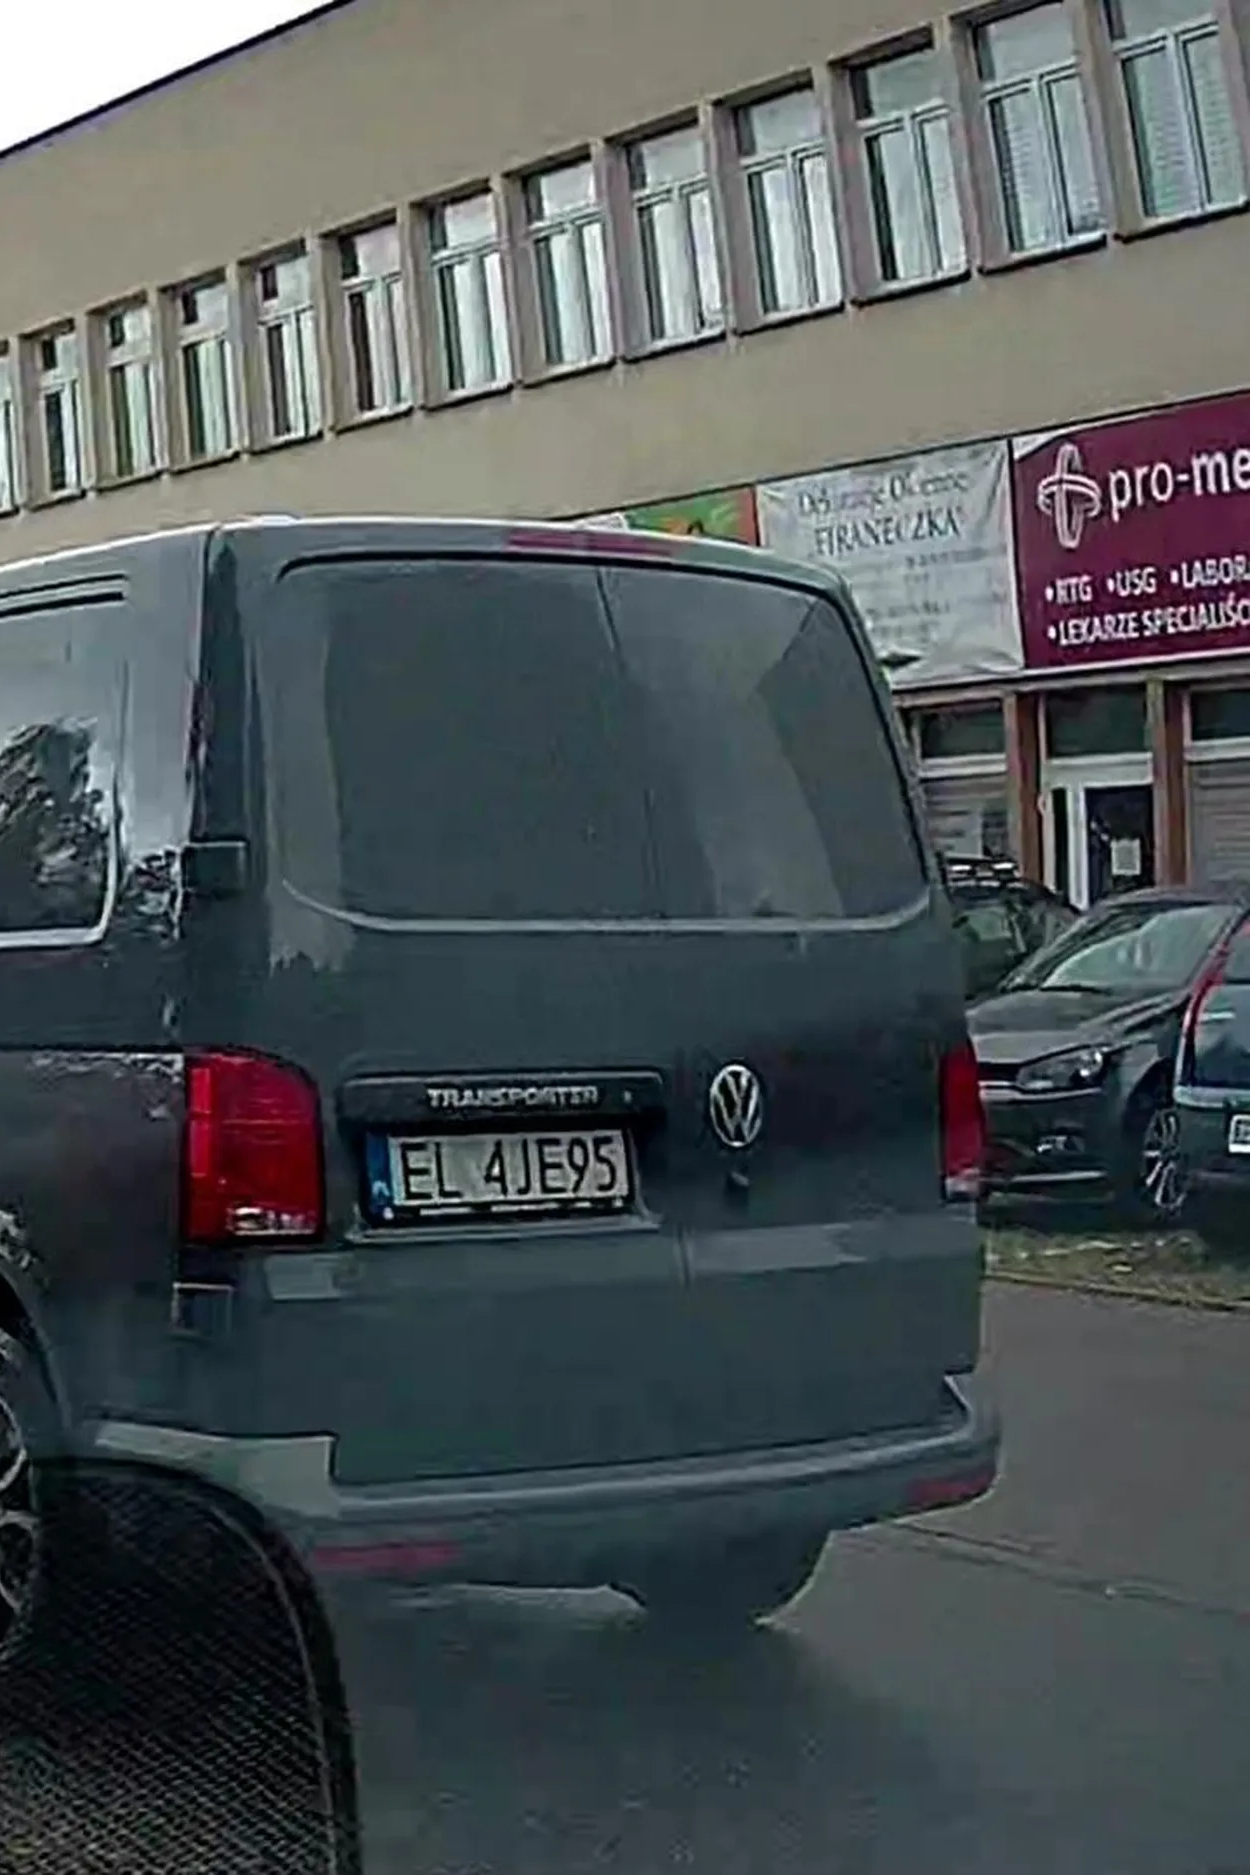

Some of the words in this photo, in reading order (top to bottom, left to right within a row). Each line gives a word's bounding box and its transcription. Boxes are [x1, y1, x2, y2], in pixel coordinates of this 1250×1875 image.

[1115, 566, 1157, 597] USG
[1181, 554, 1250, 588] LABOR
[1059, 611, 1140, 646] LEKARZE
[426, 1085, 599, 1108] TRANSPORTER
[400, 1141, 465, 1201] EL
[483, 1135, 618, 1198] 4JE95
